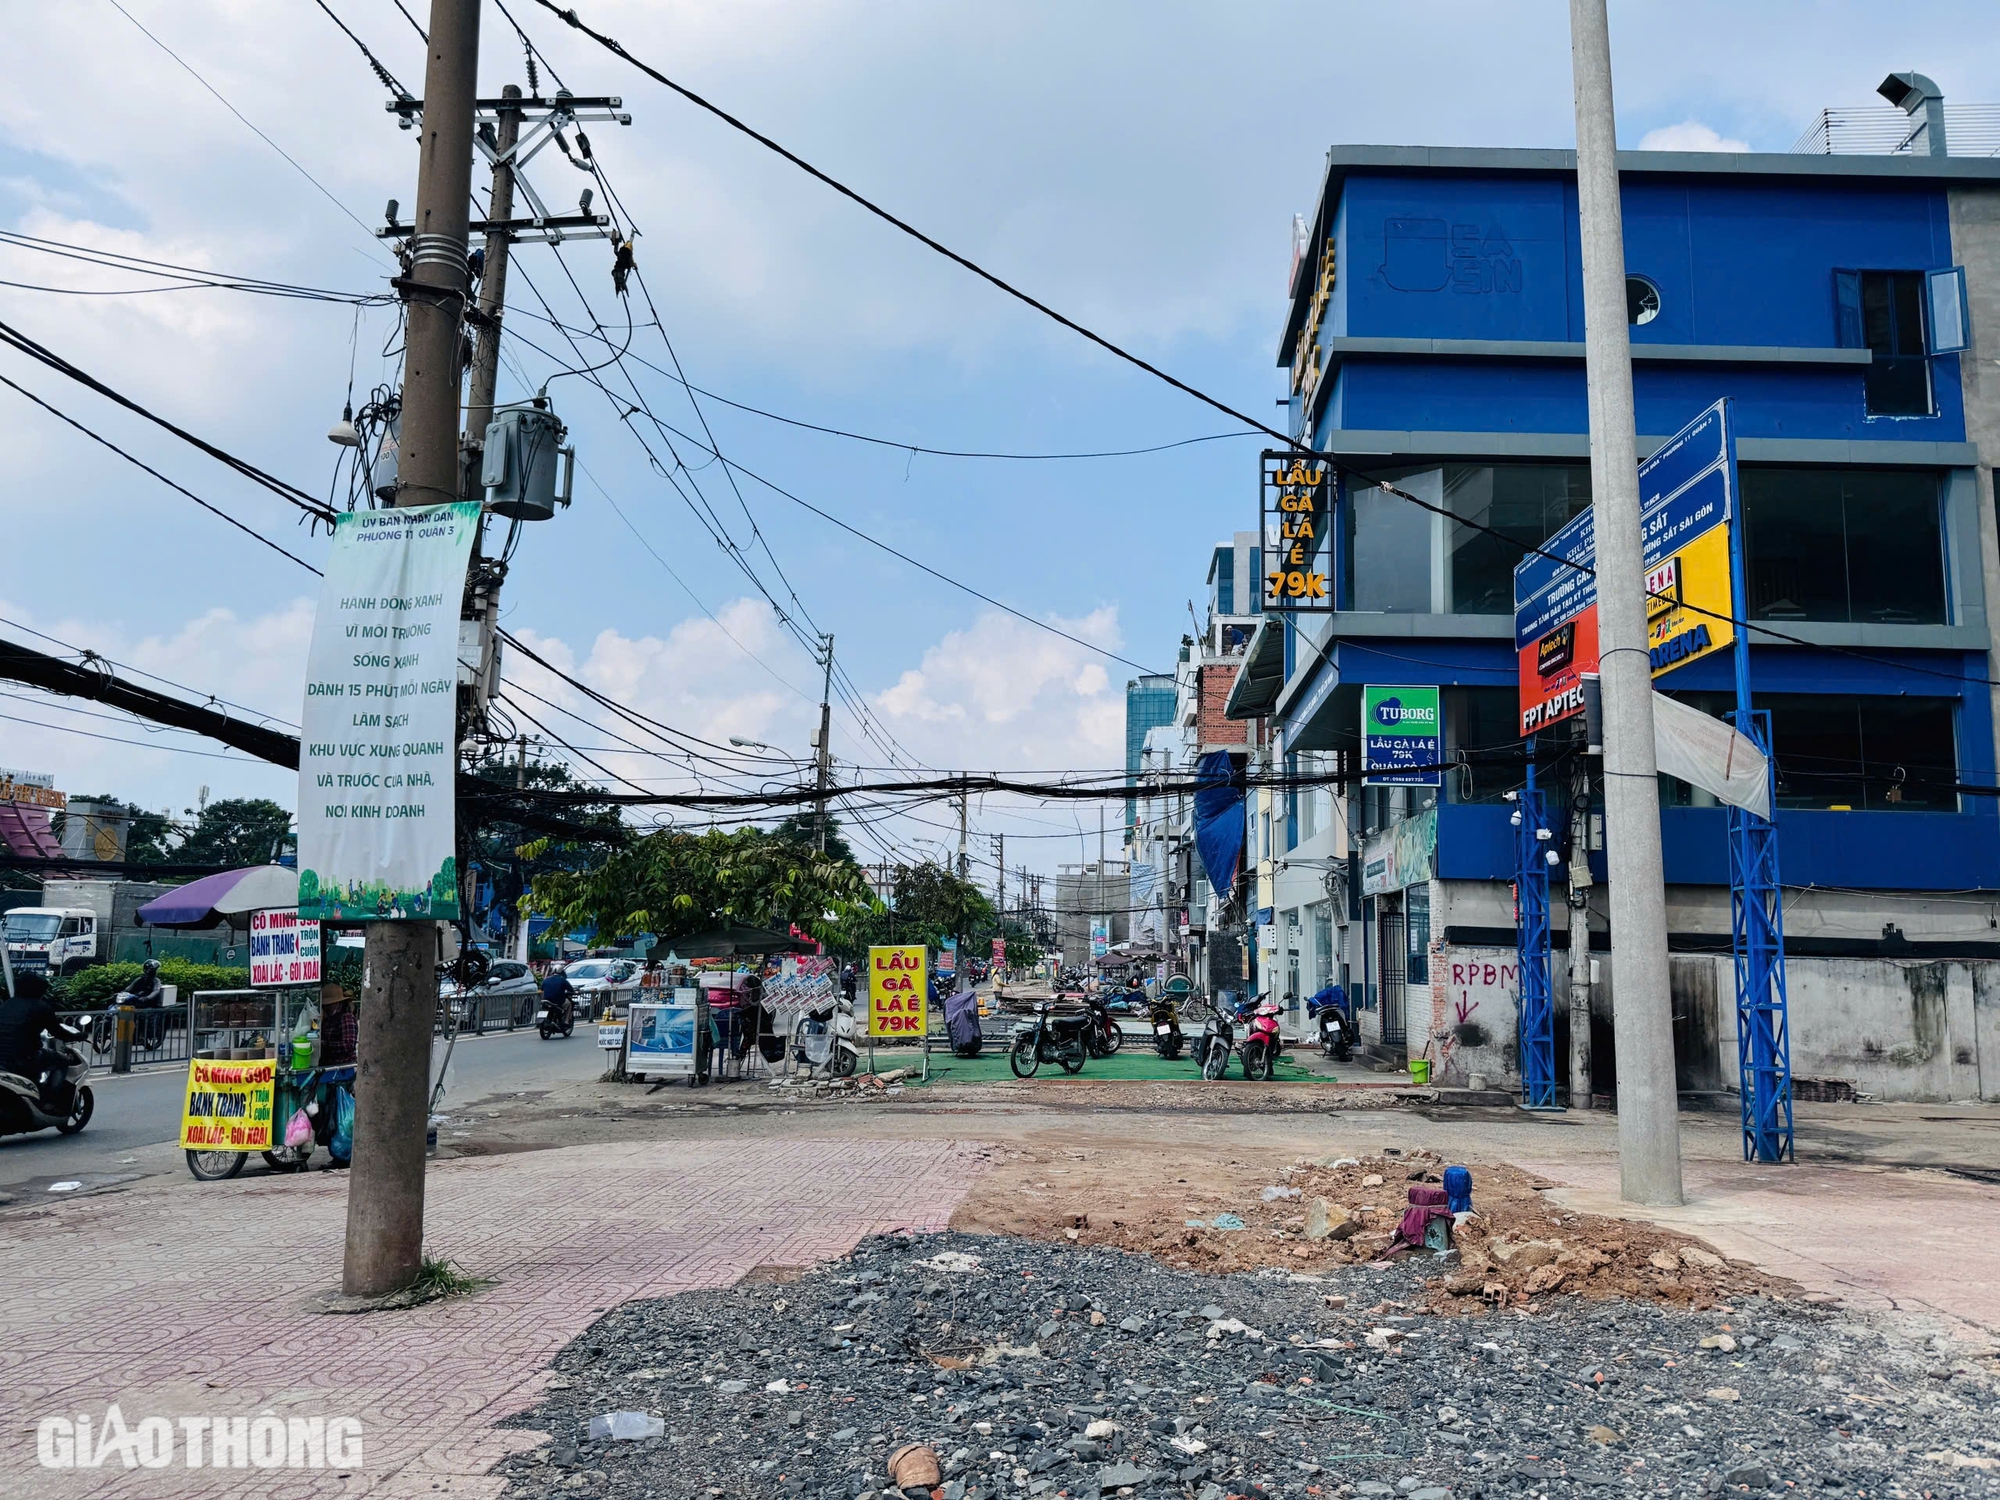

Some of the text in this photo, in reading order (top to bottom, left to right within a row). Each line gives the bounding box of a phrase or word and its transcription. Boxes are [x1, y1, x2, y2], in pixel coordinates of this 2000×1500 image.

[1276, 459, 1322, 486] LẨU
[1281, 490, 1314, 512] GÀ
[380, 516, 400, 526] BAN
[1650, 512, 1668, 535] SẮT
[1680, 515, 1693, 531] SÀI
[1695, 502, 1713, 521] GÒN
[405, 530, 413, 539] 11
[448, 526, 454, 535] 3
[1284, 518, 1314, 538] LÁ
[1290, 542, 1304, 564] É
[1566, 542, 1582, 560] KHU
[1269, 571, 1326, 597] 79K
[1650, 566, 1673, 593] ENA
[414, 594, 443, 608] XANH
[1547, 578, 1575, 606] TRƯỜNG
[346, 623, 358, 637] VÌ
[362, 624, 387, 638] MÔI
[1522, 620, 1538, 636] TRUNG
[1650, 624, 1711, 670] ARENA
[353, 651, 419, 669] SỐNG XANH
[308, 681, 344, 696] DÀNH
[348, 684, 361, 696] 15
[421, 679, 452, 694] NGÀY
[1380, 707, 1434, 720] TUBORG
[1523, 684, 1584, 729] FPT APTEC
[353, 712, 409, 729] LÀM SẠCH
[310, 744, 335, 756] KHU
[370, 745, 401, 758] XUNG
[403, 742, 443, 756] QUANH
[1412, 739, 1426, 749] LÁ
[1428, 739, 1435, 749] É
[1392, 750, 1413, 759] 79K
[317, 772, 333, 787] VÀ
[337, 772, 380, 787] TRƯỚC
[407, 771, 435, 787] NHÀ,
[325, 804, 425, 818] NƠI KINH DOANH
[253, 911, 266, 930] CÔ
[270, 912, 296, 928] MINH
[252, 932, 270, 956] BÁNH
[272, 930, 294, 955] TRÁNG
[300, 943, 319, 957] CUỐN
[876, 950, 919, 970] LẨU
[253, 961, 268, 983] XOÀI
[271, 957, 283, 982] LẮC
[303, 957, 319, 980] XOÀI
[882, 974, 914, 991] GÀ
[876, 994, 920, 1012] LÁ É
[877, 1016, 920, 1031] 79K
[195, 1063, 271, 1084] CÔ MINH 590
[189, 1086, 215, 1116] BÁNH
[216, 1087, 246, 1117] TRÁNG
[254, 1104, 270, 1120] CUỐN
[186, 1122, 206, 1143] XOÀI
[206, 1121, 225, 1144] LẮC
[246, 1123, 268, 1144] XOÀI
